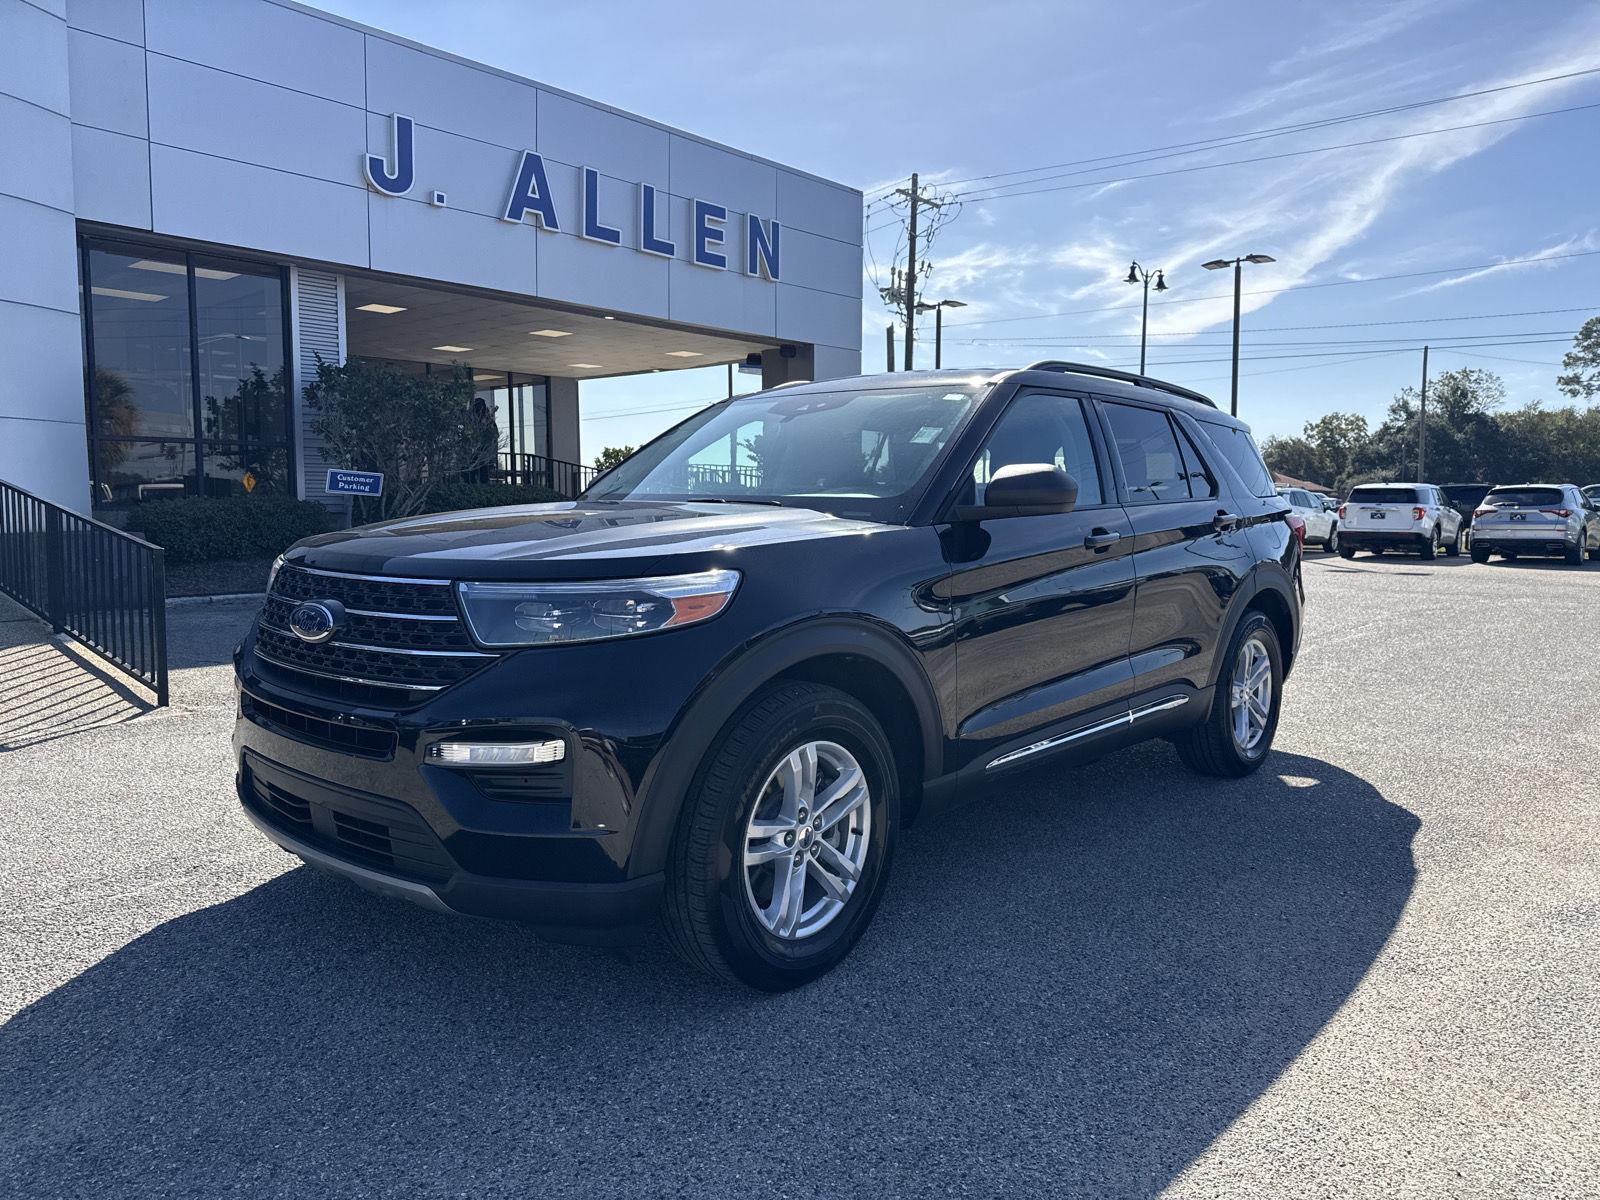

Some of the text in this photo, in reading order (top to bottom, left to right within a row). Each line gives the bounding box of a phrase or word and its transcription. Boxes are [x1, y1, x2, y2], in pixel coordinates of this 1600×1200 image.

[363, 112, 781, 282] J. ALLEN
[337, 473, 374, 483] Customer
[338, 482, 370, 492] Parking
